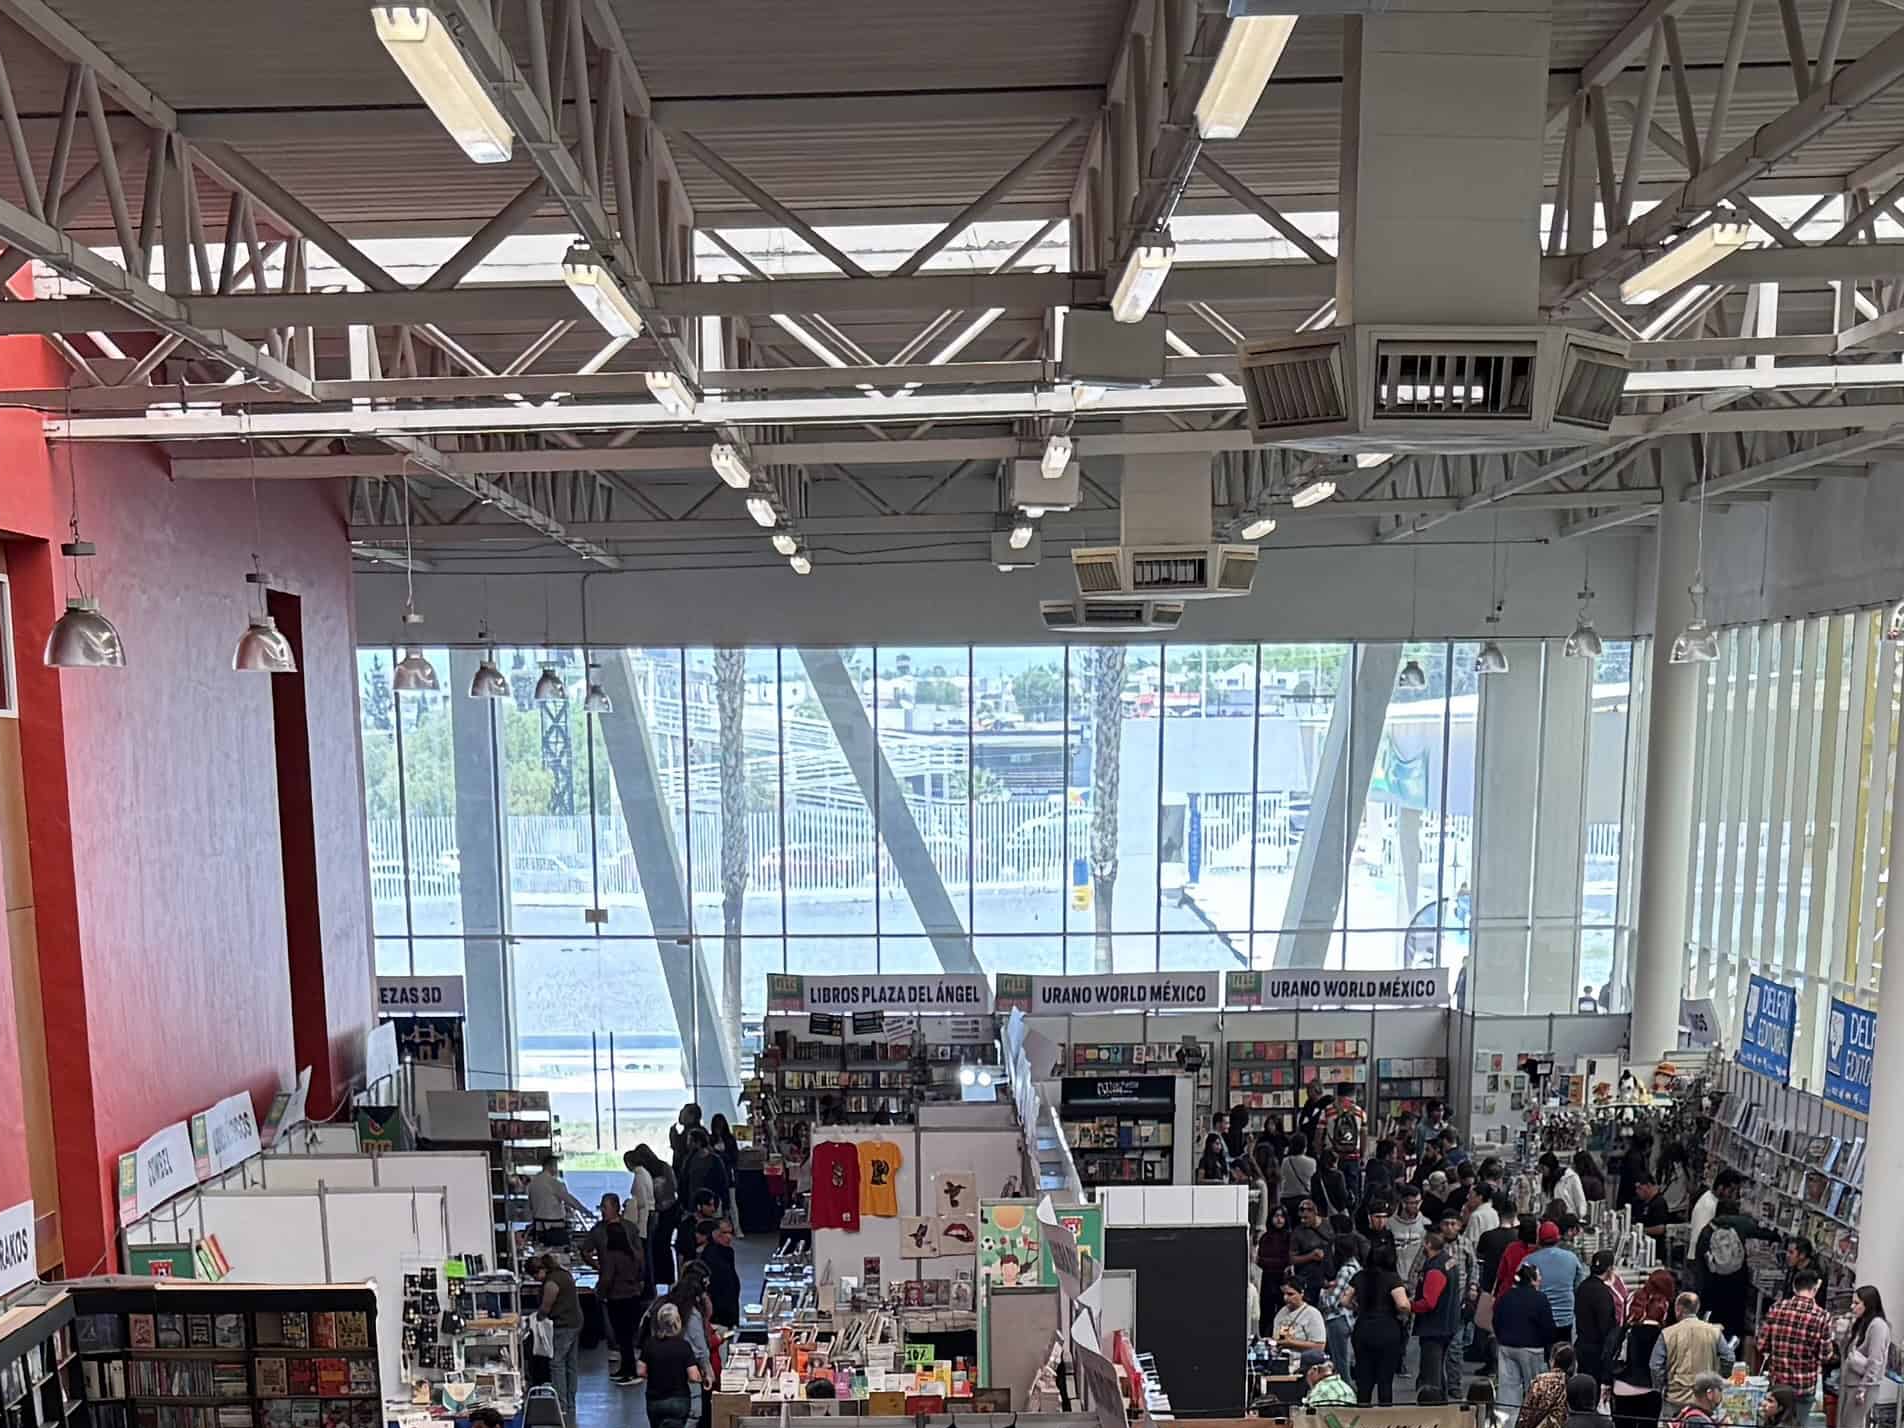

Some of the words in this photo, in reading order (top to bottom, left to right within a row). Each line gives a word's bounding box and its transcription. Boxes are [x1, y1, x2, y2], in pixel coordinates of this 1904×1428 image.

[422, 986, 442, 1004] 3D
[810, 986, 859, 1004] LIBROS
[862, 986, 904, 1003] PLAZA
[908, 986, 933, 1003] DEL
[936, 981, 980, 1002] ÁNGEL
[1042, 986, 1091, 1004] URANO
[1095, 985, 1146, 1003] WORLD
[1150, 980, 1206, 1002] MÉXICO
[1271, 979, 1320, 998] URANO
[1323, 980, 1376, 998] WORLD
[1379, 976, 1435, 998] MÉXICO
[1850, 1013, 1876, 1049] DELF
[1845, 1050, 1872, 1086] EDITO
